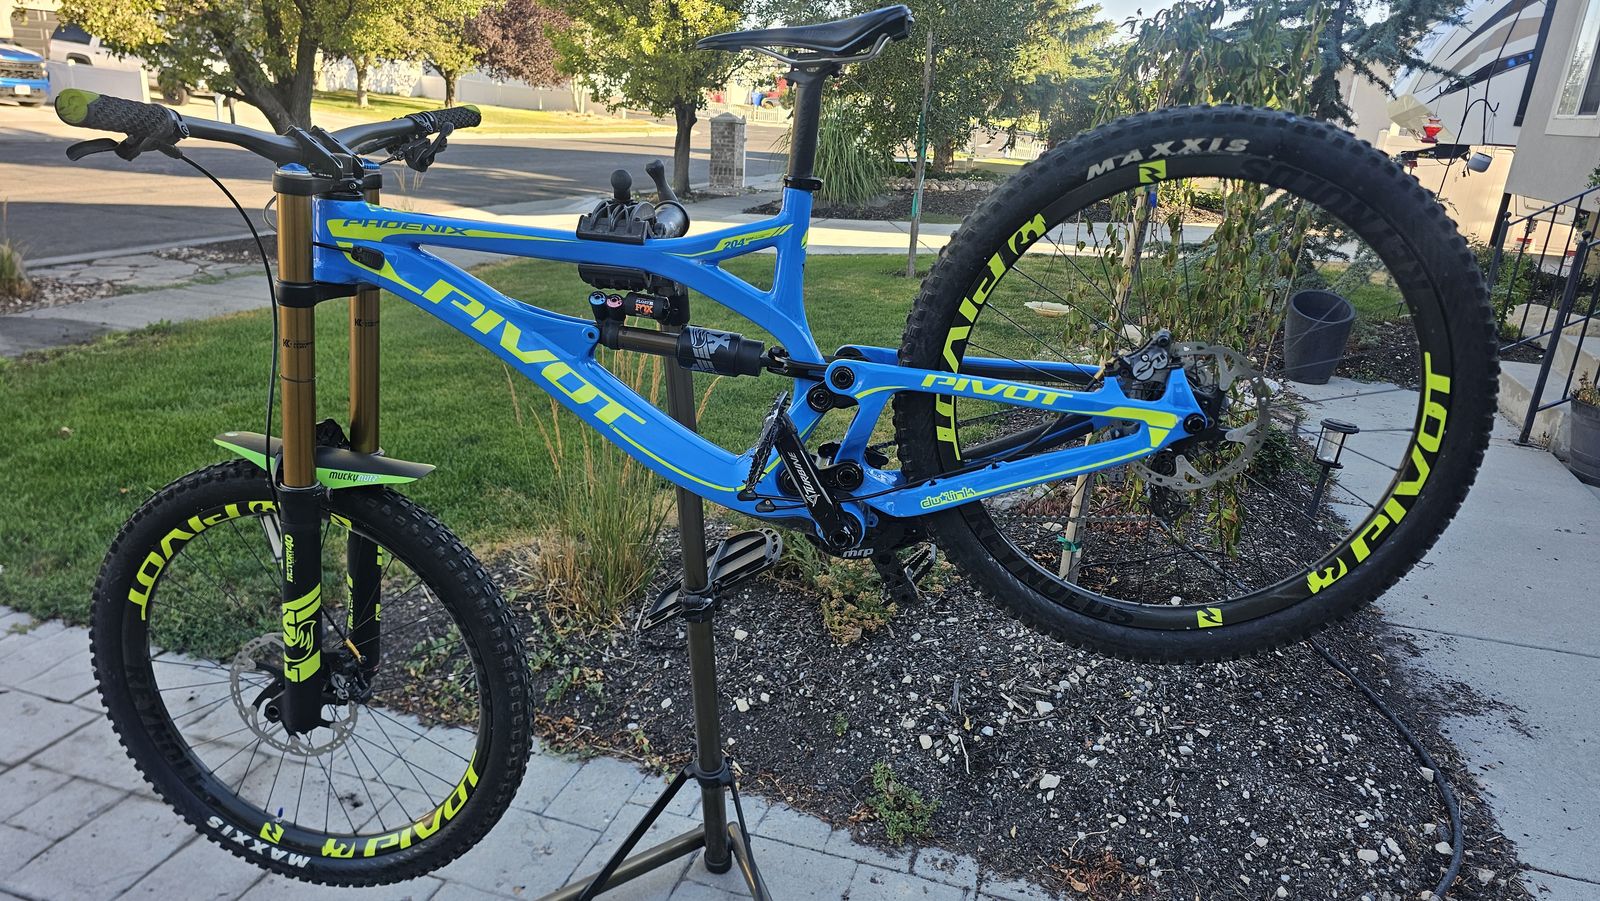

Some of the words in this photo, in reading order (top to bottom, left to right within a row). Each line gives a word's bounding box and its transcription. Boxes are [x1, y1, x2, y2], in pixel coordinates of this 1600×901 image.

[1086, 137, 1250, 182] MAXXIS
[342, 219, 471, 236] PHOENIX
[422, 278, 647, 428] PIVOT
[921, 373, 1073, 406] PIVOT
[787, 451, 816, 497] TURBINE
[1351, 351, 1450, 562] PIVOT
[127, 503, 240, 621] PIVOT
[842, 547, 874, 558] mrp
[364, 749, 479, 858] PIVOT
[206, 816, 311, 868] MAXXIS
